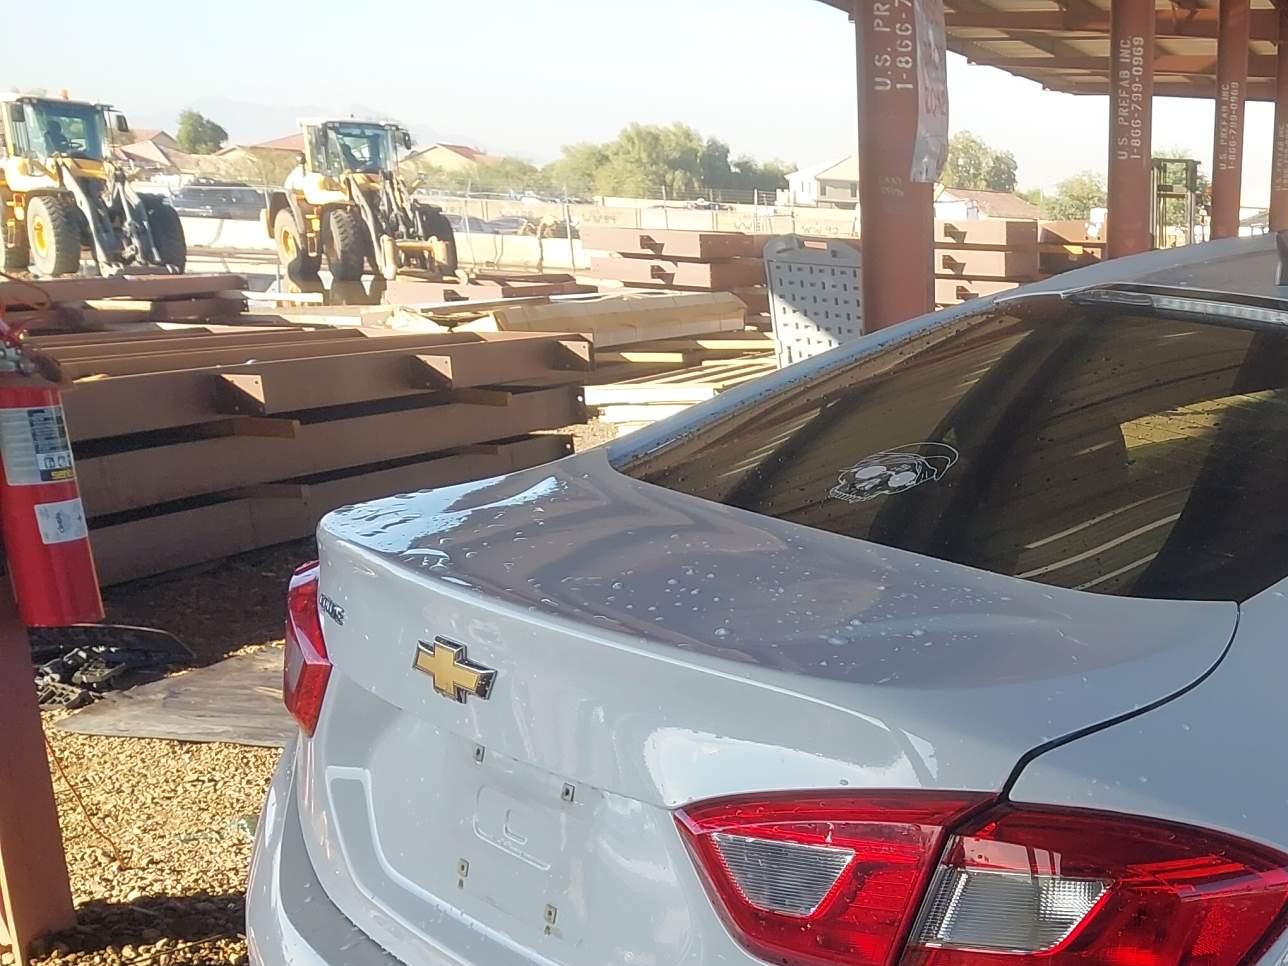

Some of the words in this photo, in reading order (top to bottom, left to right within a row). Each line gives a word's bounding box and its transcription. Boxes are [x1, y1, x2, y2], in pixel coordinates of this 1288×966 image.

[874, 47, 892, 91] U.S.
[1119, 35, 1132, 63] INC.
[1118, 70, 1130, 126] PREFAB
[1130, 36, 1144, 159] 1-866-799-0969
